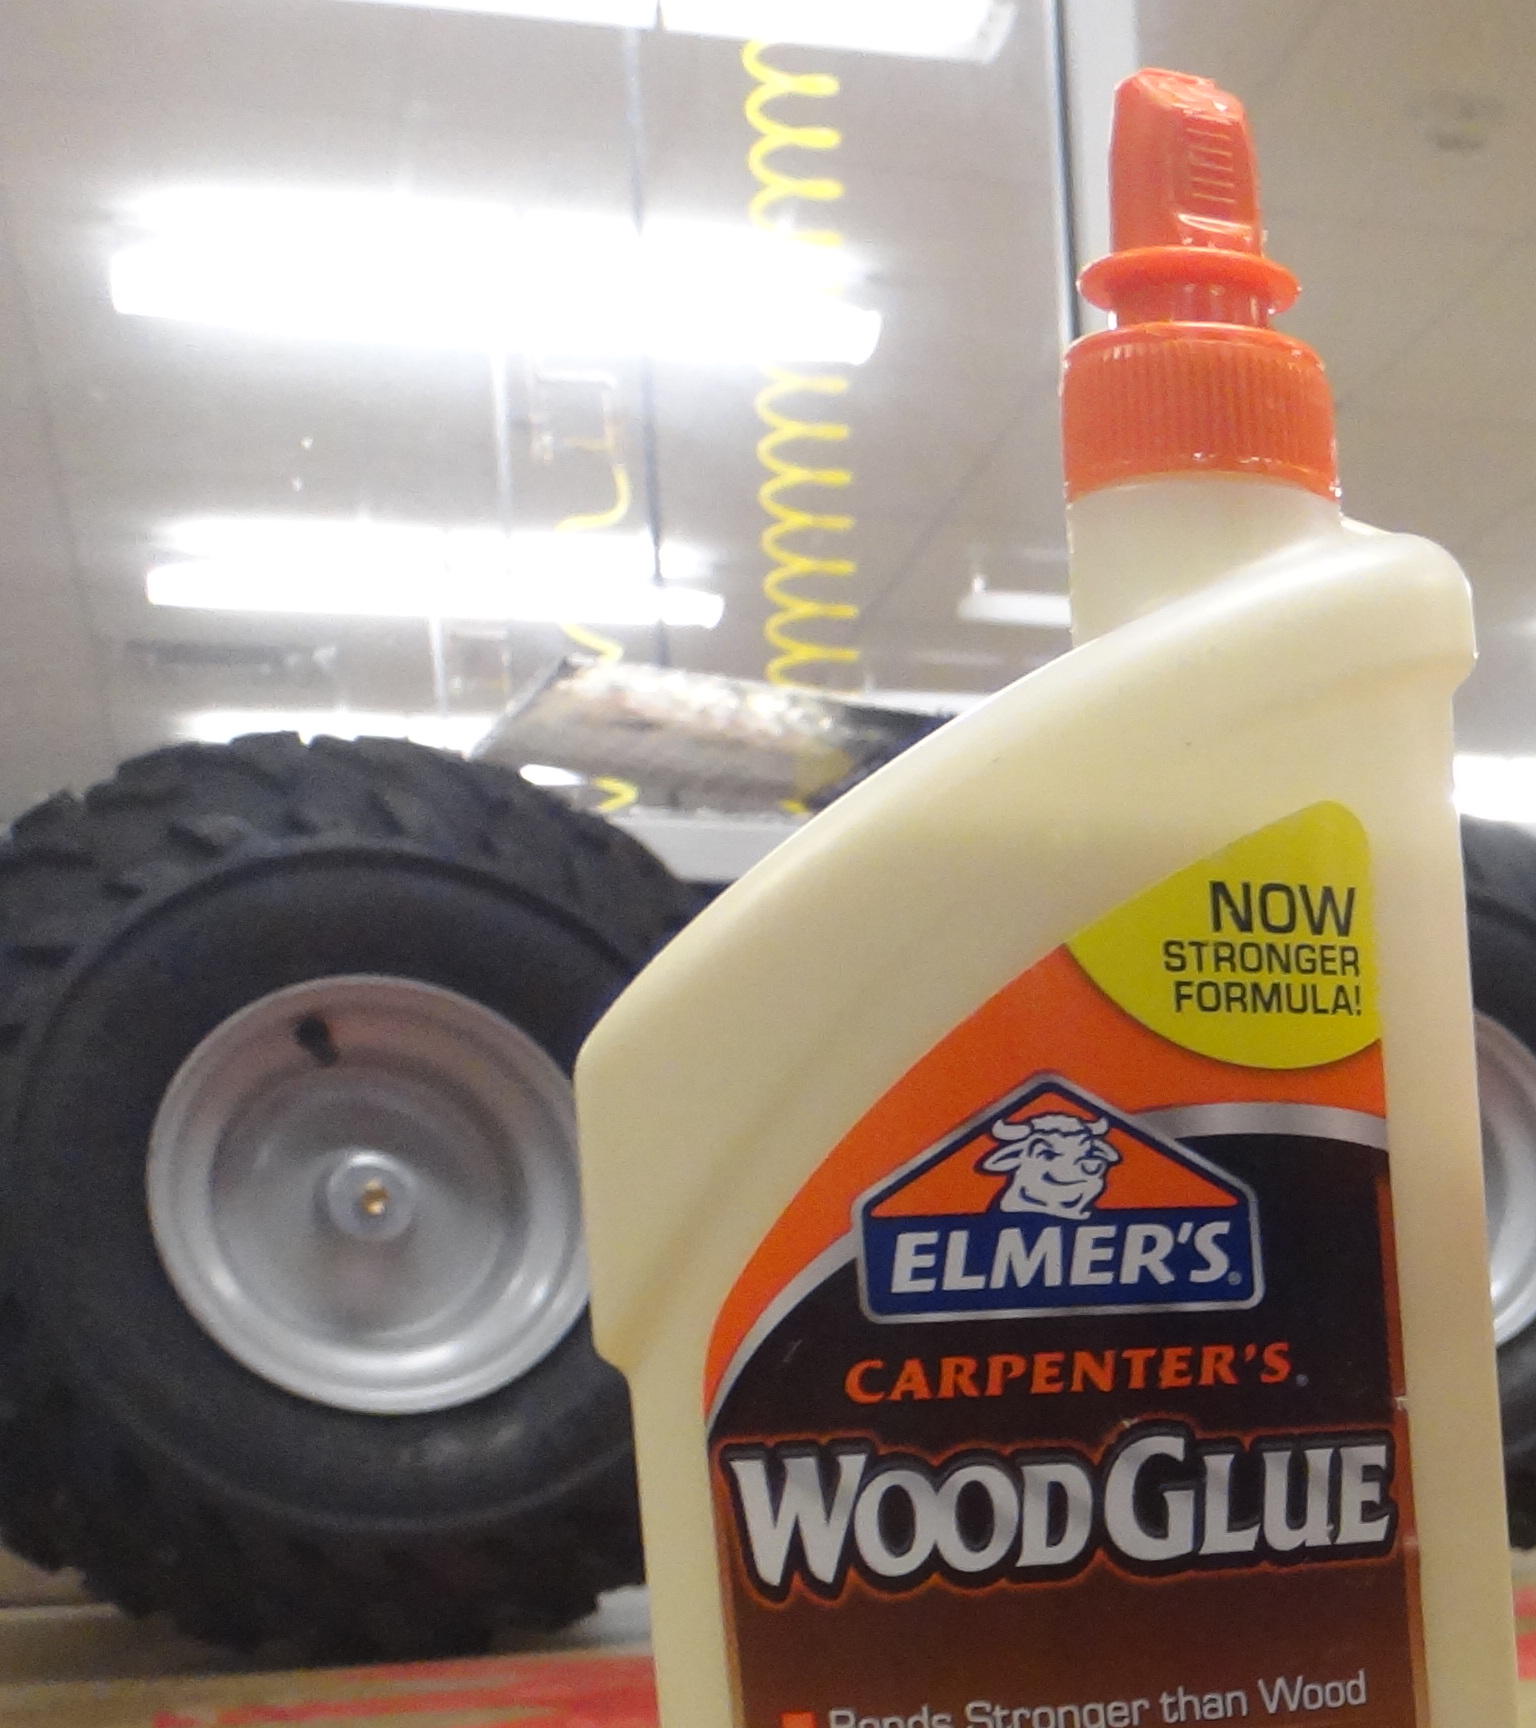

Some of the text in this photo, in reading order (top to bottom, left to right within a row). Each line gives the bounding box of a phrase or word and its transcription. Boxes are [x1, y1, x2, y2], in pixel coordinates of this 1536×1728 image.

[1209, 881, 1356, 939] NOW
[1163, 940, 1361, 978] STRONGER
[1174, 981, 1363, 1017] FORMULA!
[890, 1221, 1232, 1295] ELMER'S
[844, 1341, 1291, 1405] CARPENTER'S
[1158, 1688, 1249, 1725] than
[1257, 1670, 1368, 1715] Wood
